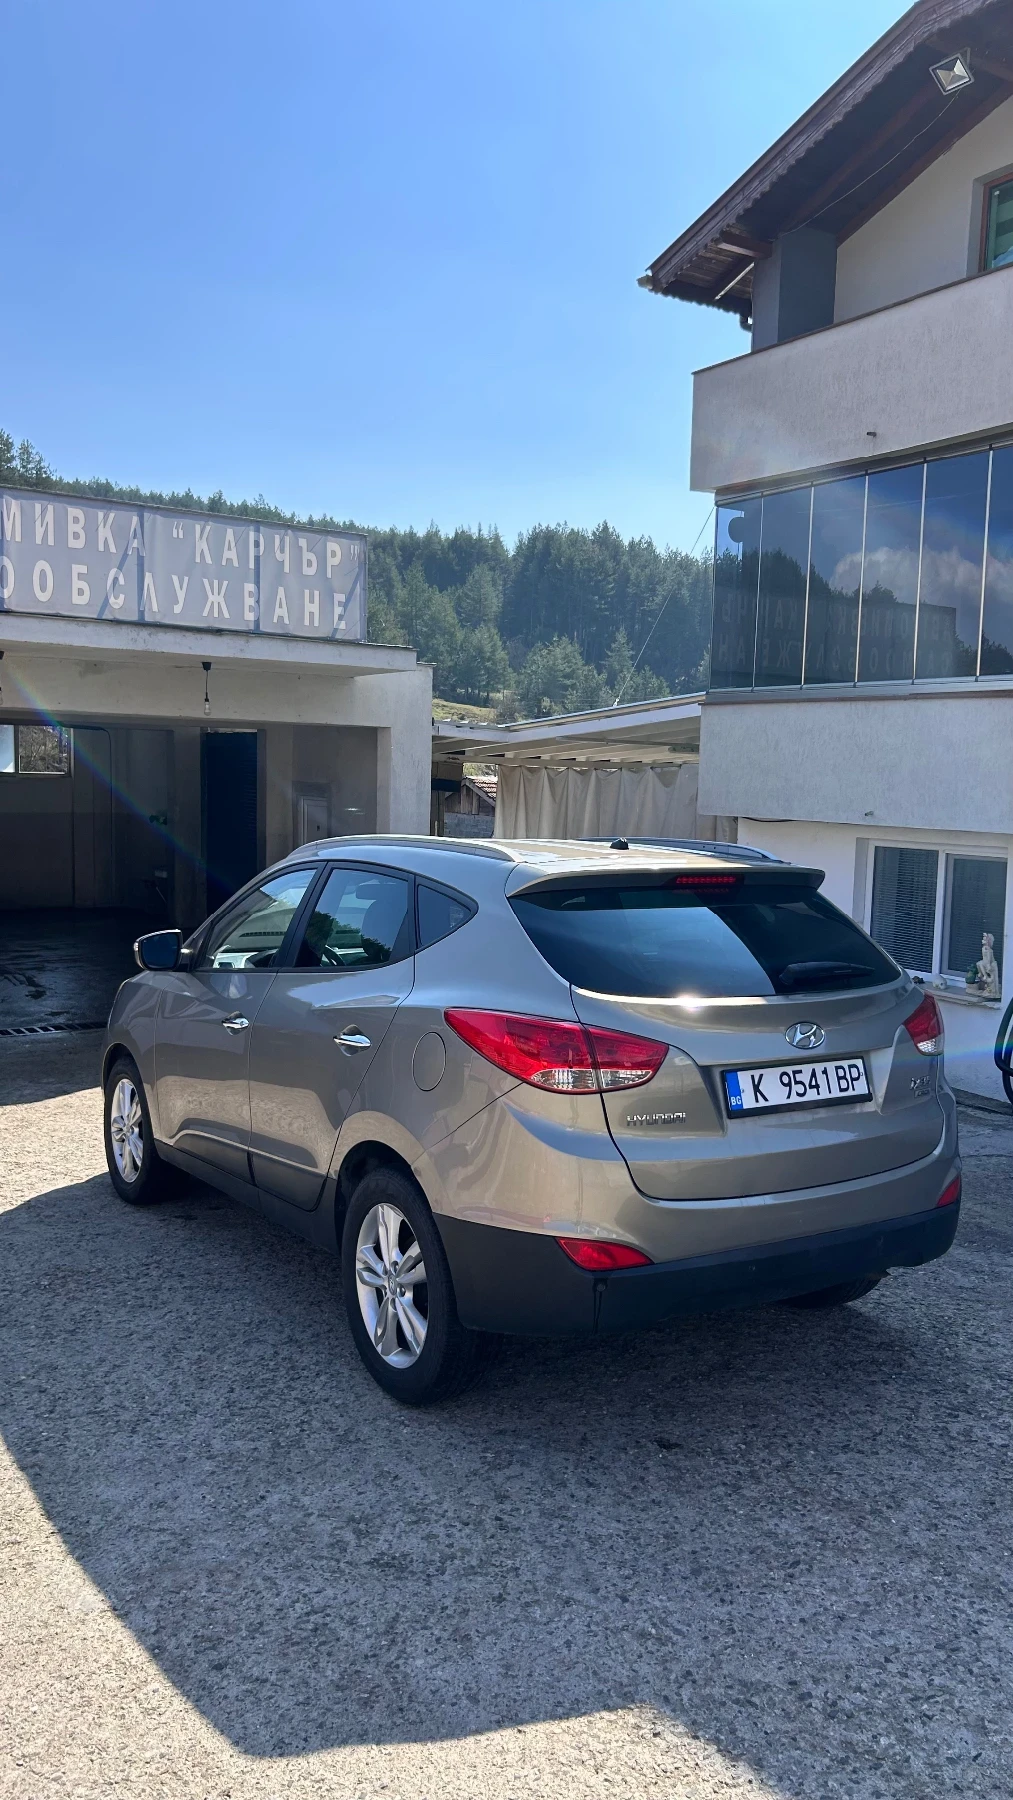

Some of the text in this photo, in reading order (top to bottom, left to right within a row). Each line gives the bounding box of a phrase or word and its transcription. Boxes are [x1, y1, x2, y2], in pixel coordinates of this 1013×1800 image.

[0, 497, 146, 557] МИВКА
[0, 555, 347, 630] ООБСЛУЖВАНЕ
[730, 1096, 742, 1106] BG
[751, 1073, 769, 1103] K
[626, 1112, 686, 1126] HYUNDAI
